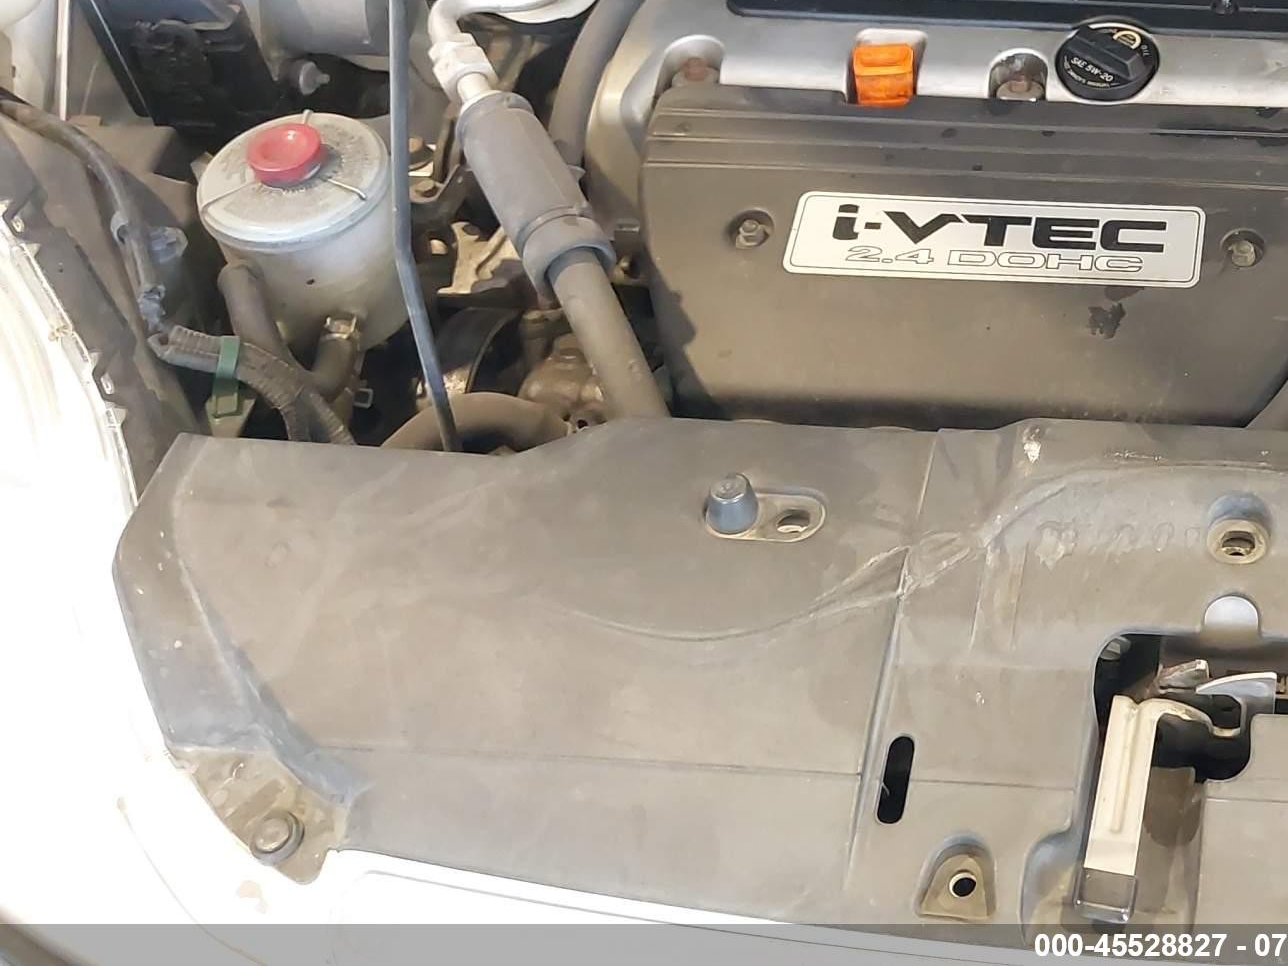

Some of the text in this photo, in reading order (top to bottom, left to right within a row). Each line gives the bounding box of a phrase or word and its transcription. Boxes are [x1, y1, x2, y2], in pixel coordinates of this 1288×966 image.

[1071, 57, 1086, 69] SAE
[1085, 64, 1113, 82] 5W-20
[831, 203, 1167, 253] i-VTEC
[845, 246, 1143, 273] 2.4 DOHC
